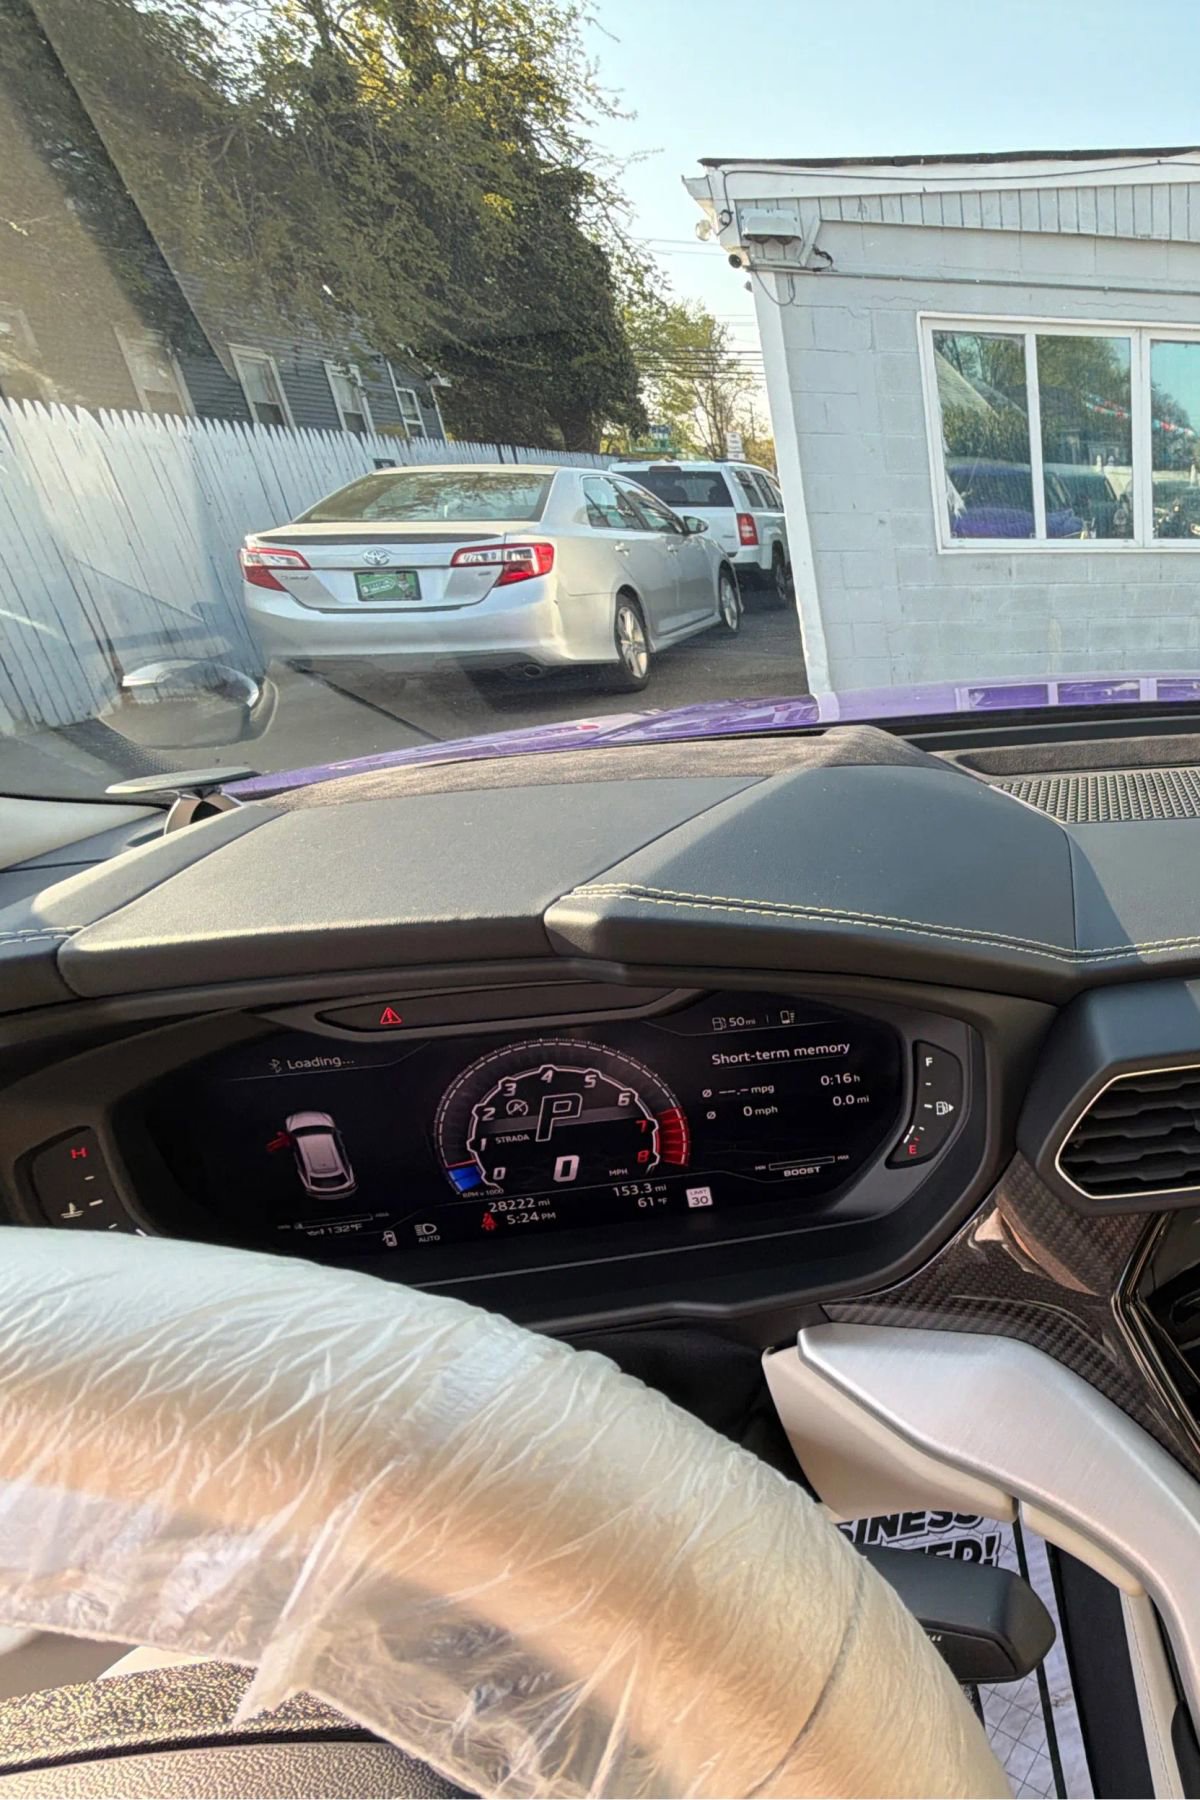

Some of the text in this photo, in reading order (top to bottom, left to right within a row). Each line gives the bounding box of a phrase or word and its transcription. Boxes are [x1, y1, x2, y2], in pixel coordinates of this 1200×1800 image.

[728, 1016, 746, 1027] 50
[711, 1043, 851, 1065] Short-term memory
[286, 1056, 355, 1070] Loading...
[925, 1057, 933, 1067] F
[540, 1069, 553, 1083] 4
[584, 1074, 597, 1088] 5
[820, 1072, 852, 1086] 0:16
[503, 1082, 517, 1097] 3
[751, 1084, 775, 1095] mpg
[617, 1092, 632, 1106] 6
[832, 1094, 870, 1107] 0.0 mi
[481, 1107, 496, 1121] 2
[535, 1093, 583, 1142] P
[743, 1105, 779, 1117] 0 mph
[480, 1138, 488, 1151] 1
[495, 1133, 530, 1144] STRADA
[908, 1145, 917, 1154] E
[492, 1167, 506, 1181] 0
[553, 1155, 580, 1183] 0
[609, 1168, 628, 1177] MPH
[783, 1166, 821, 1177] BOOST
[612, 1182, 667, 1198] 153.3 mi
[488, 1197, 551, 1213] 28222 mi
[637, 1197, 655, 1208] 61
[692, 1195, 709, 1206] 30
[506, 1211, 556, 1225] 5:24 PM
[418, 1234, 441, 1243] AUTO
